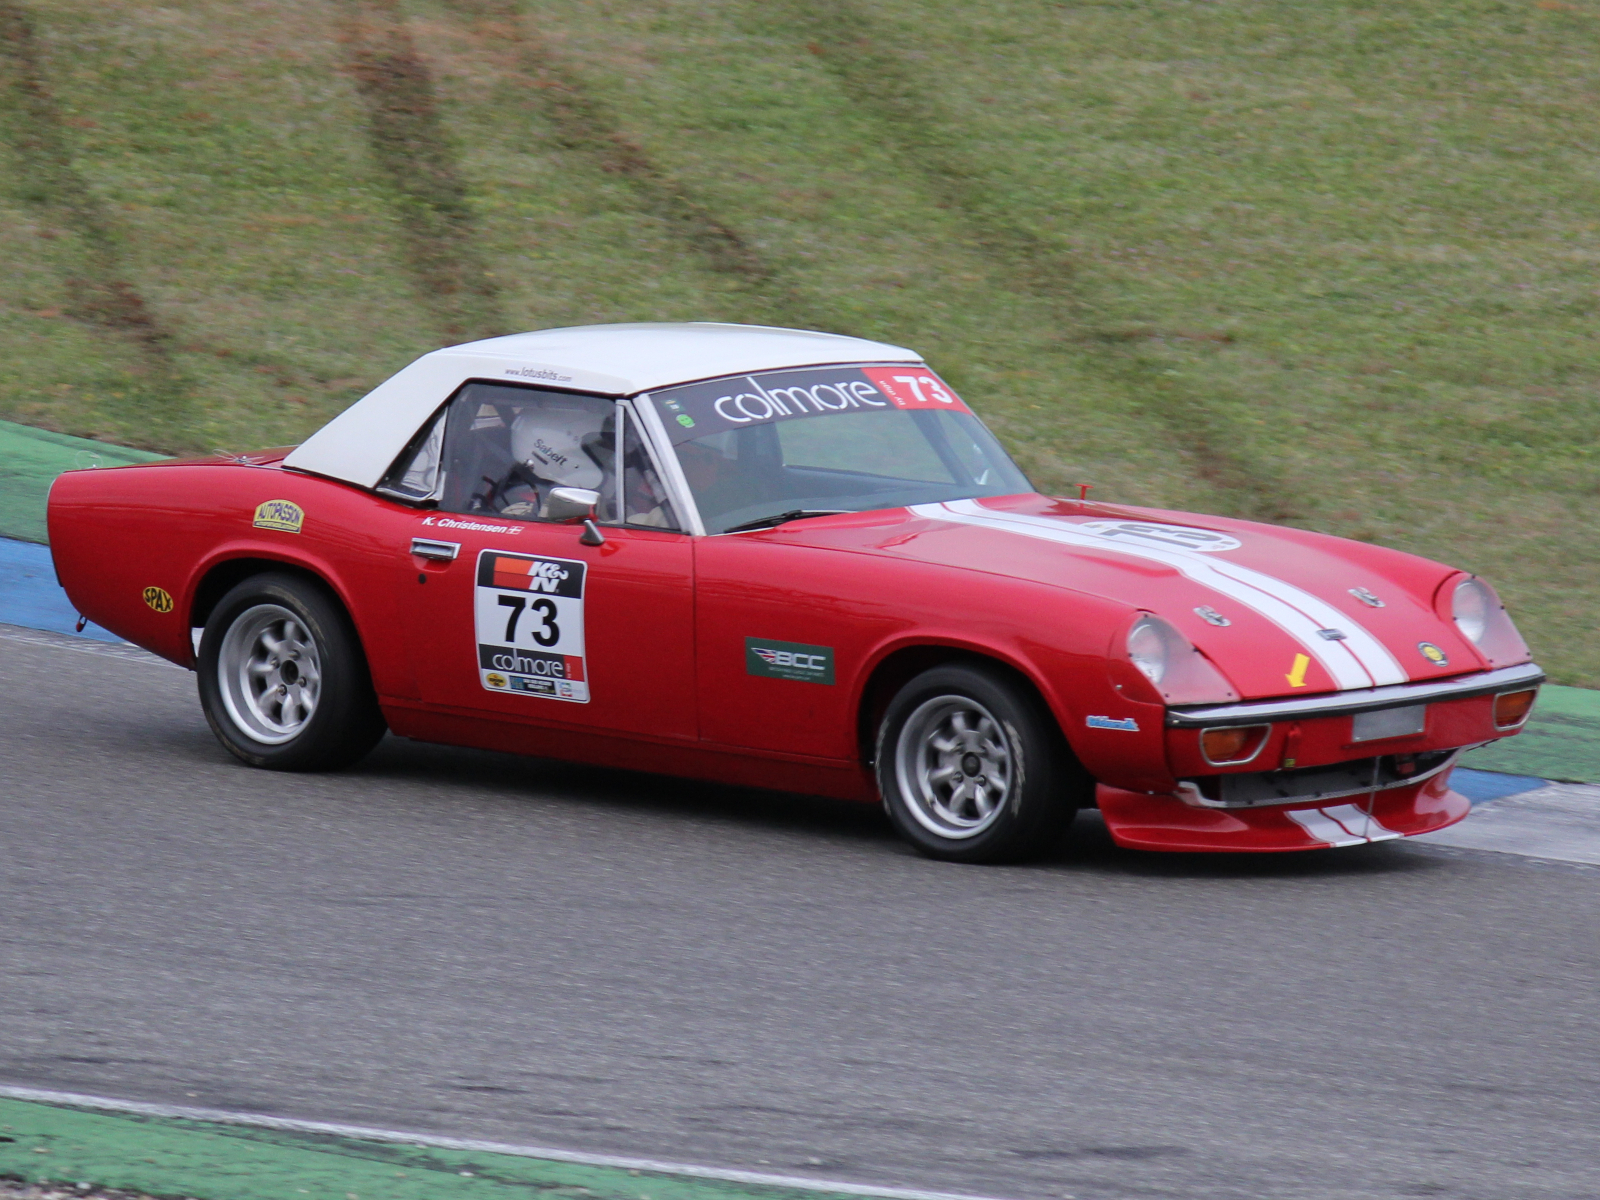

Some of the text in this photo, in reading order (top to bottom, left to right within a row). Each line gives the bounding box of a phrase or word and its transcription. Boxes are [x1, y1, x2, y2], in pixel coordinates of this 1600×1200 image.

[714, 376, 887, 423] colmore
[892, 375, 953, 404] 73
[258, 502, 301, 526] AUTOPASSION
[421, 516, 509, 534] K. Christensen
[145, 587, 172, 612] SPAX
[498, 594, 560, 648] 73
[492, 648, 564, 678] colmore
[775, 650, 826, 671] BCC
